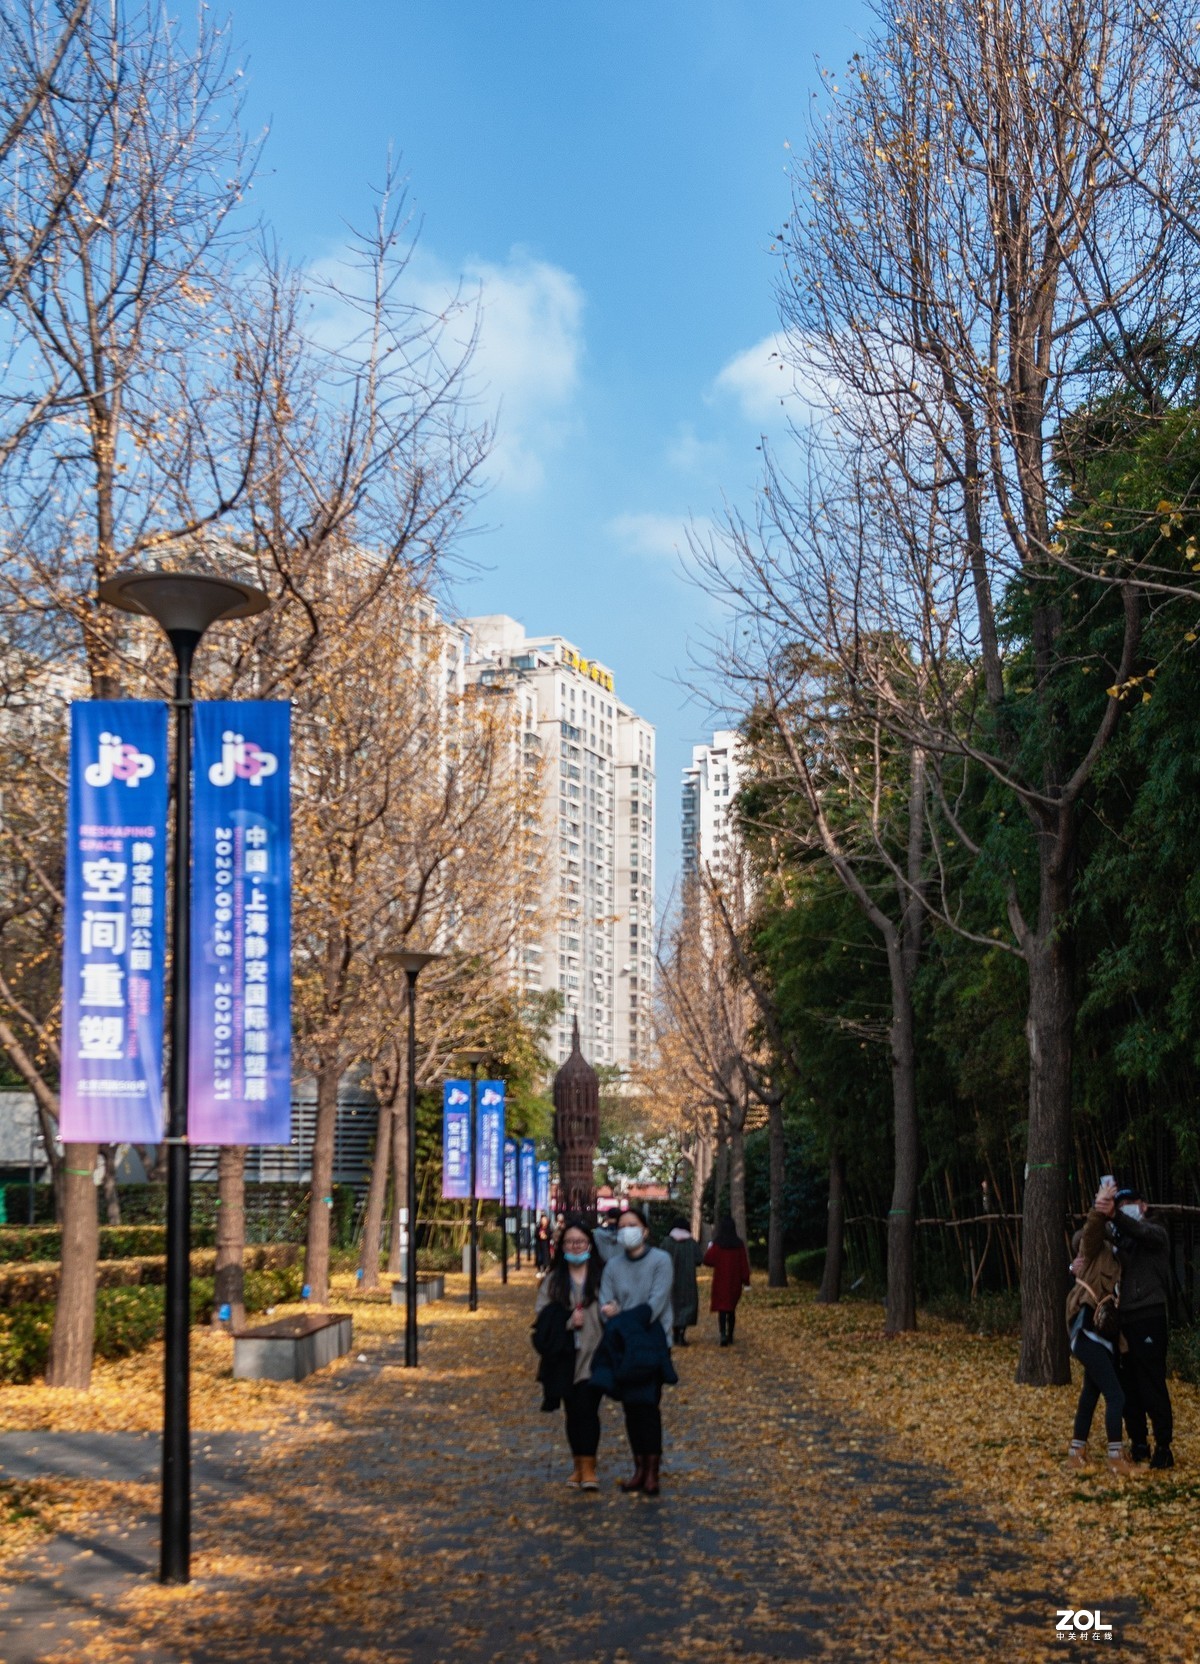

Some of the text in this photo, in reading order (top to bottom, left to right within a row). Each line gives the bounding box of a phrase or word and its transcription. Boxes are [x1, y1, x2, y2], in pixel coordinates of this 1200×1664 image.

[215, 827, 233, 956] 2020.09.26
[78, 858, 127, 1059] 空间重塑
[214, 982, 232, 1100] 2020.12.31
